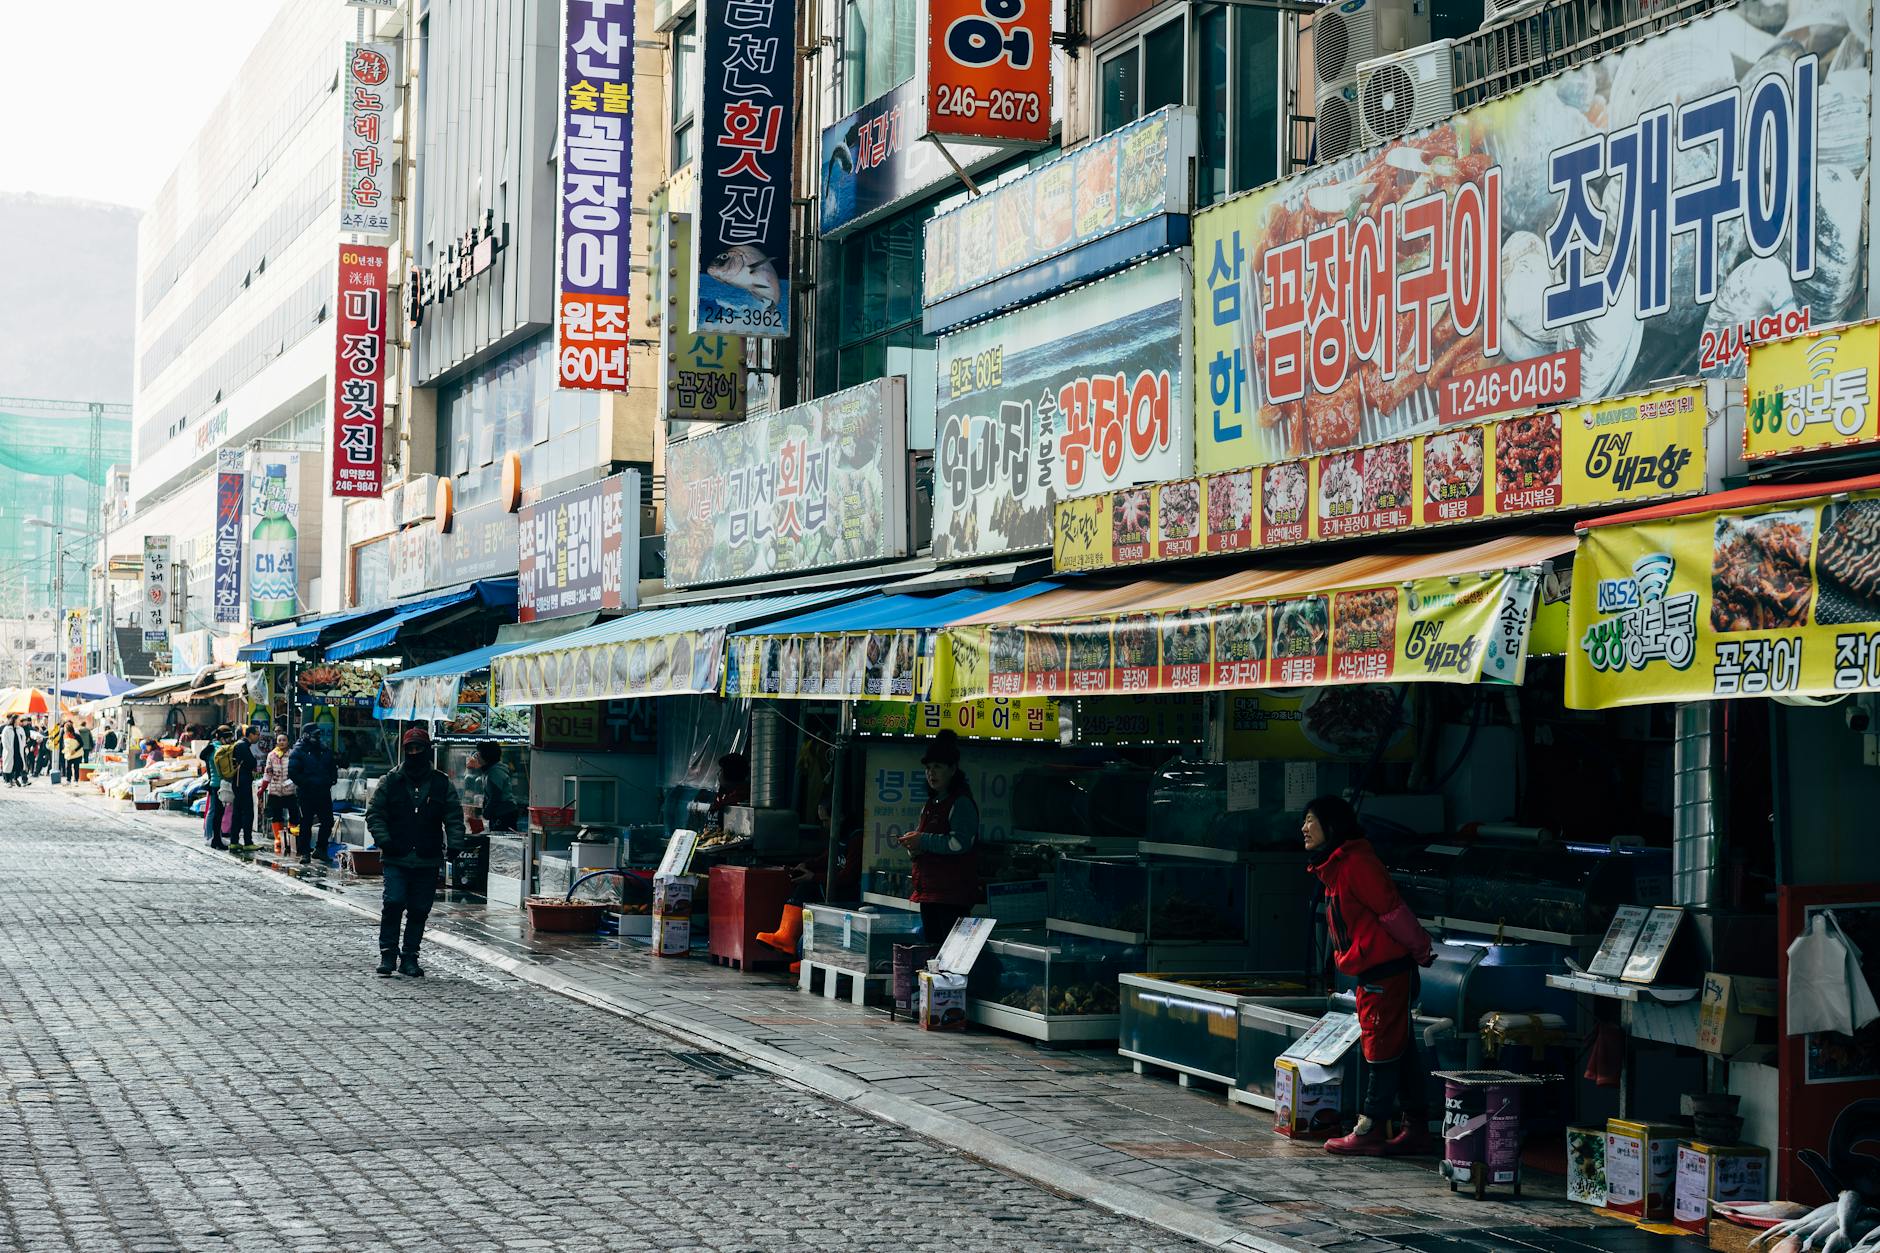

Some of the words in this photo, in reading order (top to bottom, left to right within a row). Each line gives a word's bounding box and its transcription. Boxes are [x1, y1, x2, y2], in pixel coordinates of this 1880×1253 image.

[568, 80, 631, 113] 숯불
[937, 85, 1040, 123] 246-2673
[352, 86, 383, 208] 노래타운
[564, 115, 627, 290] 꼼장어
[1543, 52, 1818, 329] 조개구이
[562, 301, 626, 343] 원조
[704, 307, 783, 328] 243-3962
[341, 287, 381, 464] 미정횟집
[561, 345, 627, 386] 60년
[677, 370, 737, 410] 꼼장어
[950, 356, 973, 398] 원조
[976, 344, 1004, 390] 60년
[1447, 358, 1568, 416] T.246-0405
[941, 399, 1032, 511] 엄마집
[1038, 387, 1057, 488] 숯불
[1059, 368, 1171, 491] 꼼장어
[1585, 431, 1633, 479] 6시
[1612, 443, 1693, 492] 내고향
[568, 495, 603, 581] 꼼장어
[603, 492, 623, 538] 원조
[535, 508, 558, 590] 부산
[1599, 579, 1637, 609] KBS2
[1218, 661, 1261, 686] 조개구이
[1281, 658, 1316, 683] 해물탕
[1714, 636, 1802, 694] 꼼장어
